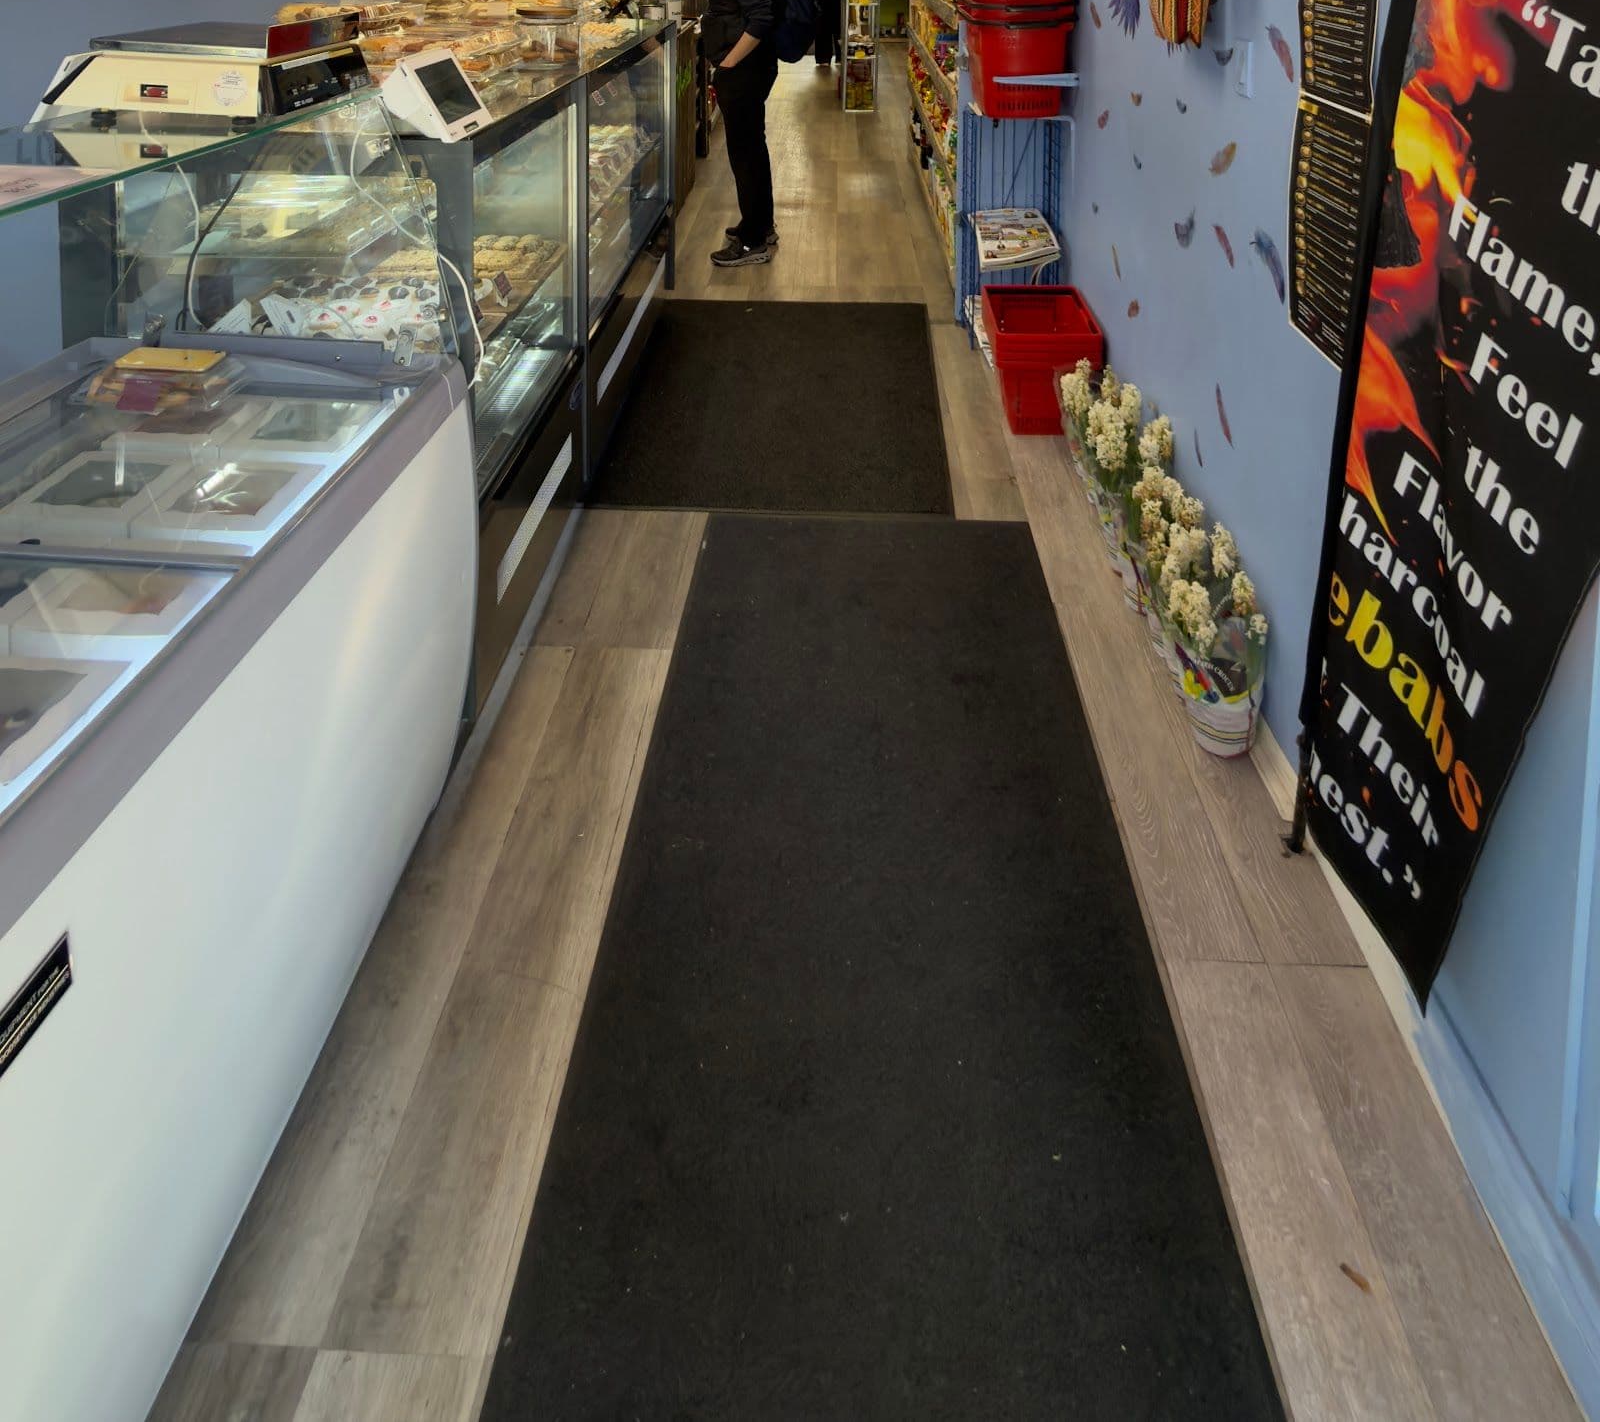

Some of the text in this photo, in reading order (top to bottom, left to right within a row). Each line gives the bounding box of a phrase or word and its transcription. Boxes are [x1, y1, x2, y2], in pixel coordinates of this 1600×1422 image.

[1448, 193, 1600, 376] Flame,
[1469, 332, 1584, 470] Feel
[1393, 451, 1513, 631] Flavor
[1464, 444, 1540, 556] the
[1338, 489, 1485, 719] harcoal
[1336, 681, 1440, 848] Their
